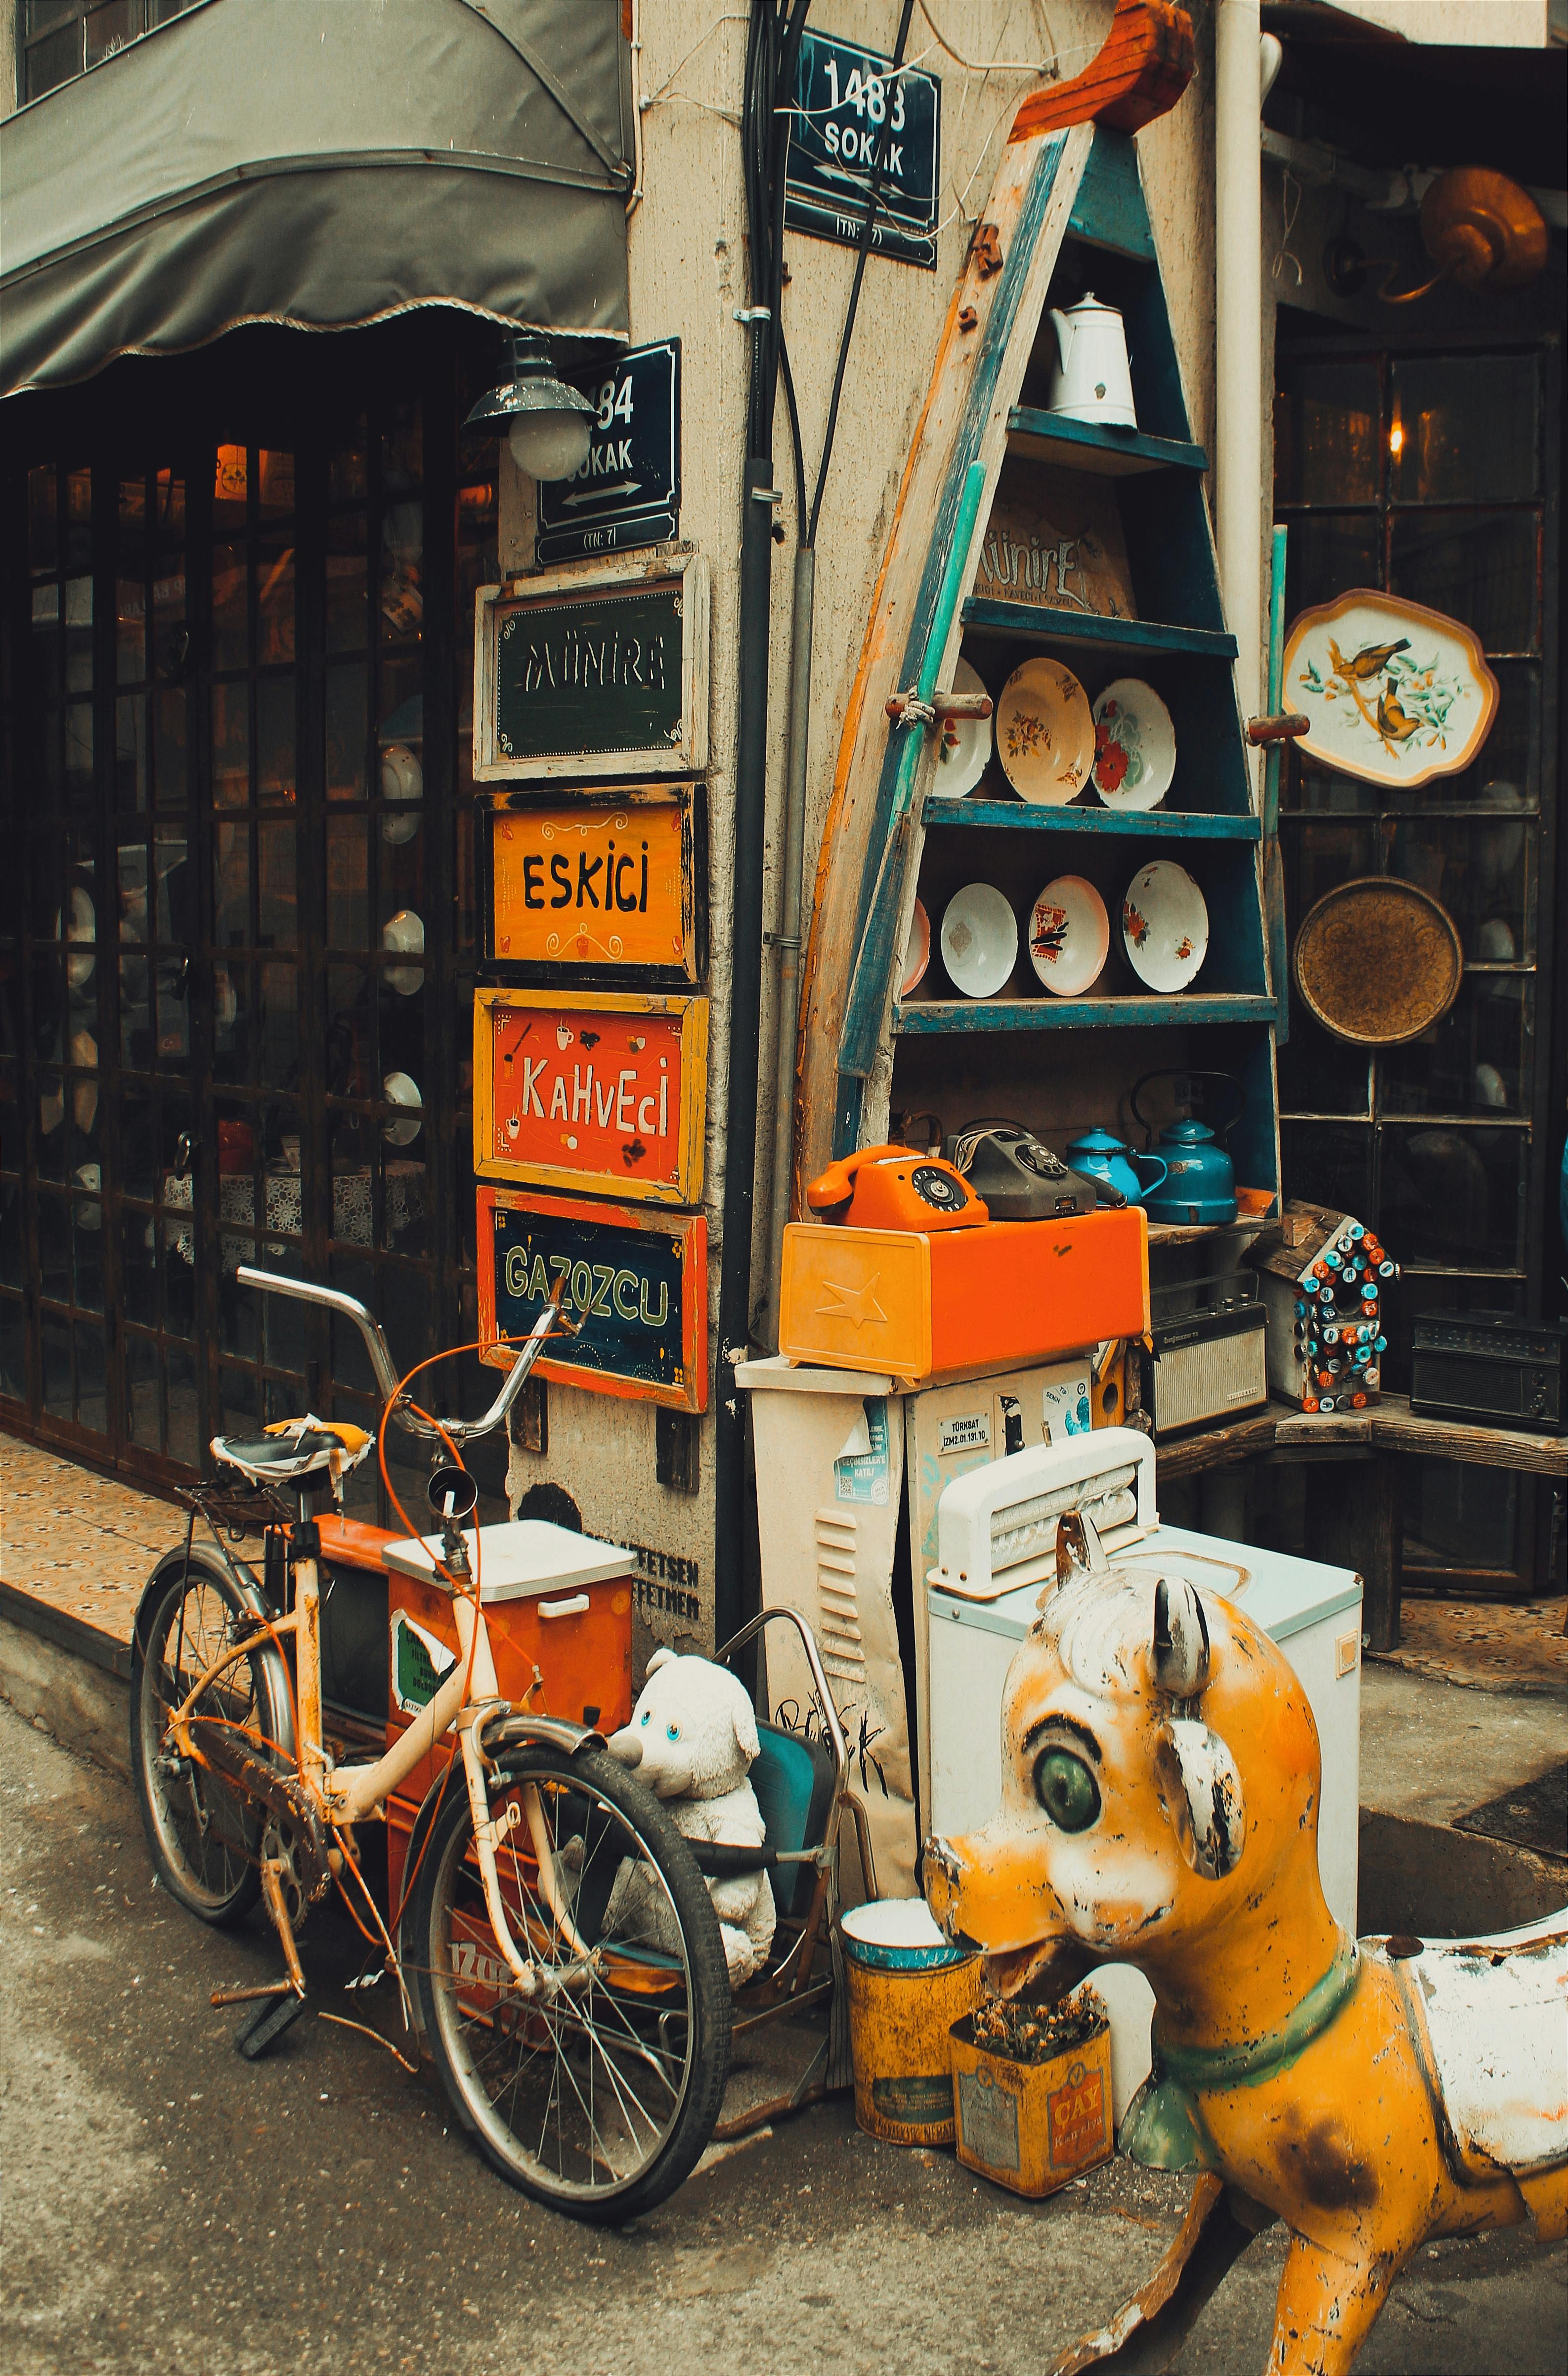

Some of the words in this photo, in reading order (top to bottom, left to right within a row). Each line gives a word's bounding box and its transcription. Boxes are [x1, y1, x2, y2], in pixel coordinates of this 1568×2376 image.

[825, 59, 905, 131] 1483
[587, 375, 634, 430] 84
[584, 530, 603, 550] (TN:
[523, 840, 649, 913] ESKİCİ
[505, 1245, 668, 1327] GAZOZCU
[1045, 1391, 1060, 1404] SENİN
[943, 1431, 985, 1447] İZM2.01.131.10
[952, 1418, 979, 1432] TÜRKSAT
[1055, 2082, 1100, 2129] ÇAY
